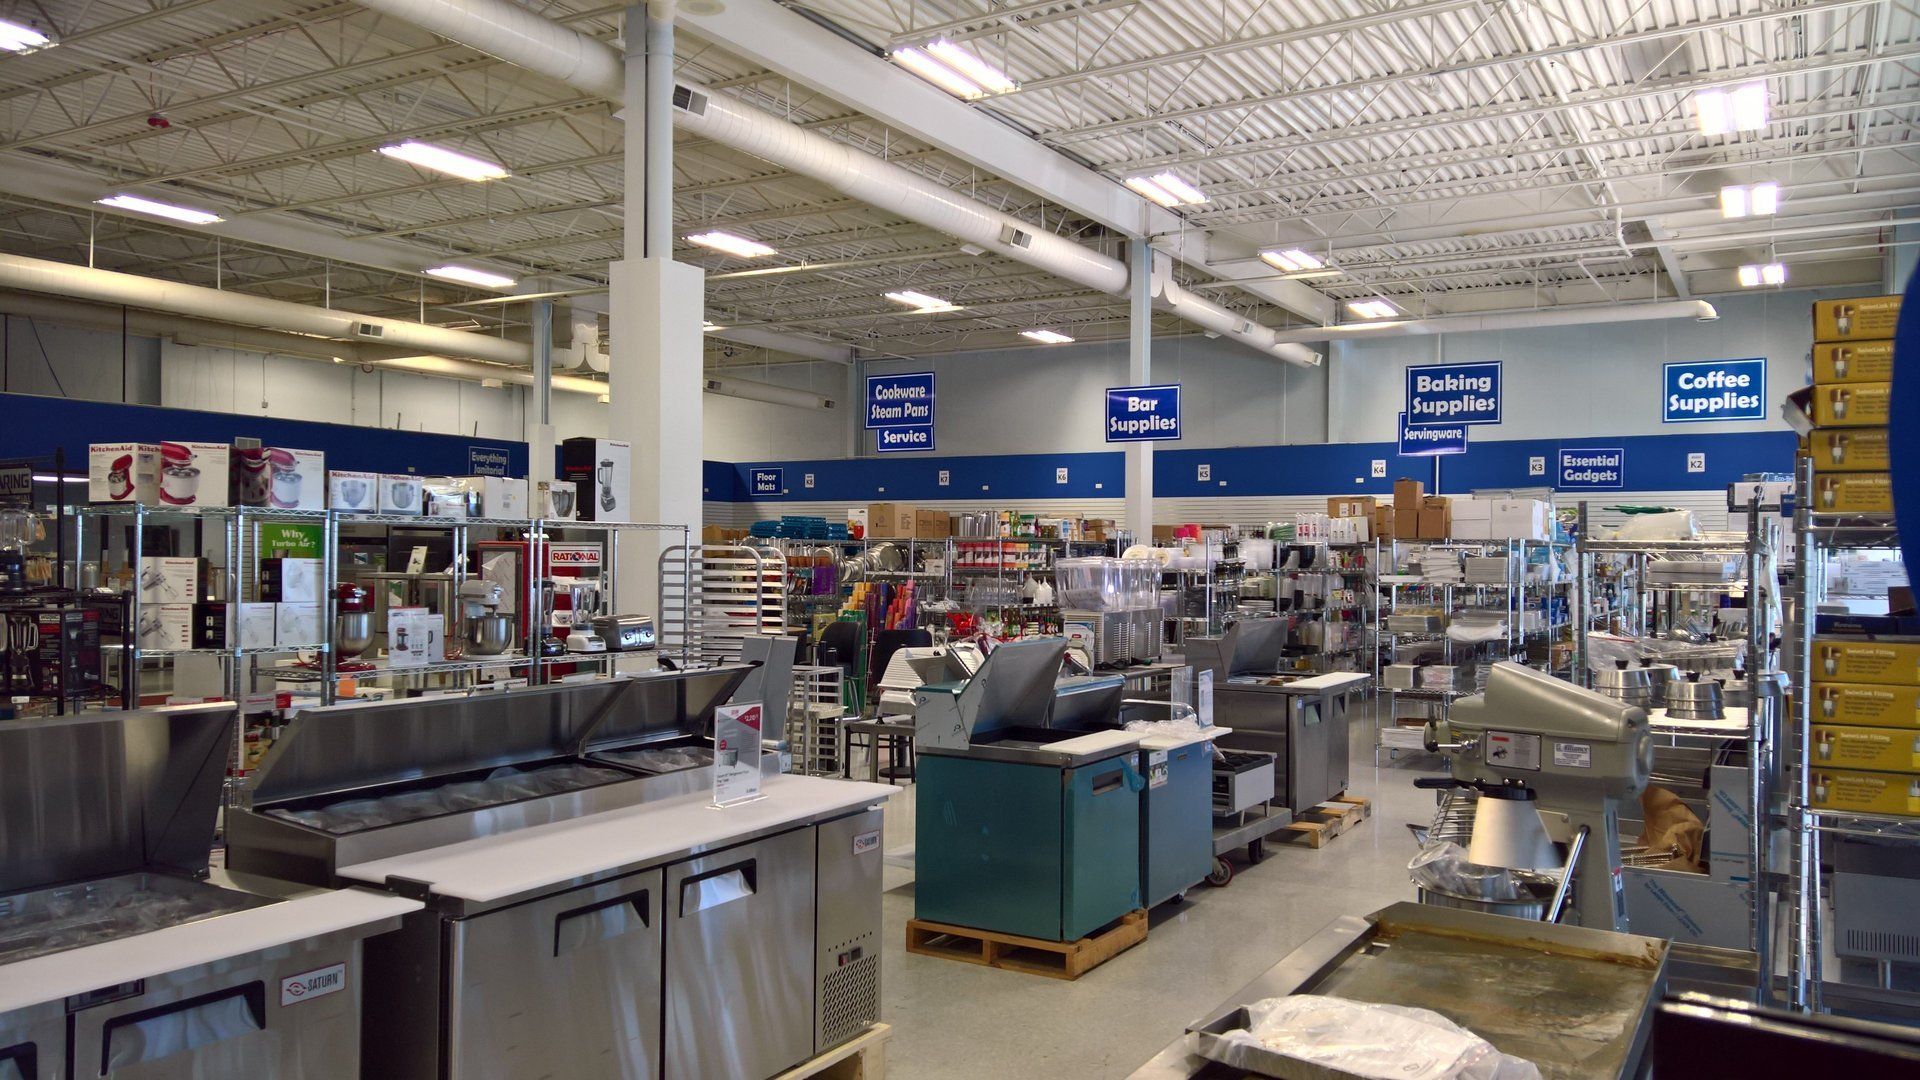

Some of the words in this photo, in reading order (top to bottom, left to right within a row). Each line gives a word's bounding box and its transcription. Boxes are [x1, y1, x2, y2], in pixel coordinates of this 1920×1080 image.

[1417, 374, 1492, 393] Baking
[1678, 371, 1750, 390] Coffee
[875, 384, 926, 400] Cookware
[1128, 396, 1158, 413] Bar
[1412, 394, 1496, 416] Supplies
[1669, 392, 1759, 413] Supplies
[871, 403, 902, 420] Steam
[904, 402, 929, 418] Pans
[1110, 415, 1176, 434] Supplies
[883, 430, 927, 444] Service
[1404, 427, 1463, 441] Servingware
[90, 445, 132, 453] KitchenAid
[471, 451, 507, 465] Everything
[1563, 454, 1619, 467] Essential
[1690, 460, 1703, 469] K2
[473, 463, 505, 475] Janitorial
[1199, 470, 1209, 478] K5
[1373, 466, 1384, 474] K4
[1531, 463, 1543, 472] K3
[331, 471, 375, 479] KitchenAid
[757, 472, 776, 482] Floor
[1057, 473, 1067, 481] K6
[1564, 469, 1617, 483] Gadgets
[757, 482, 776, 491] Mats
[281, 529, 305, 540] Why
[271, 540, 296, 548] Turbo
[552, 551, 599, 561] RATIONAL
[308, 973, 338, 992] SATURN
